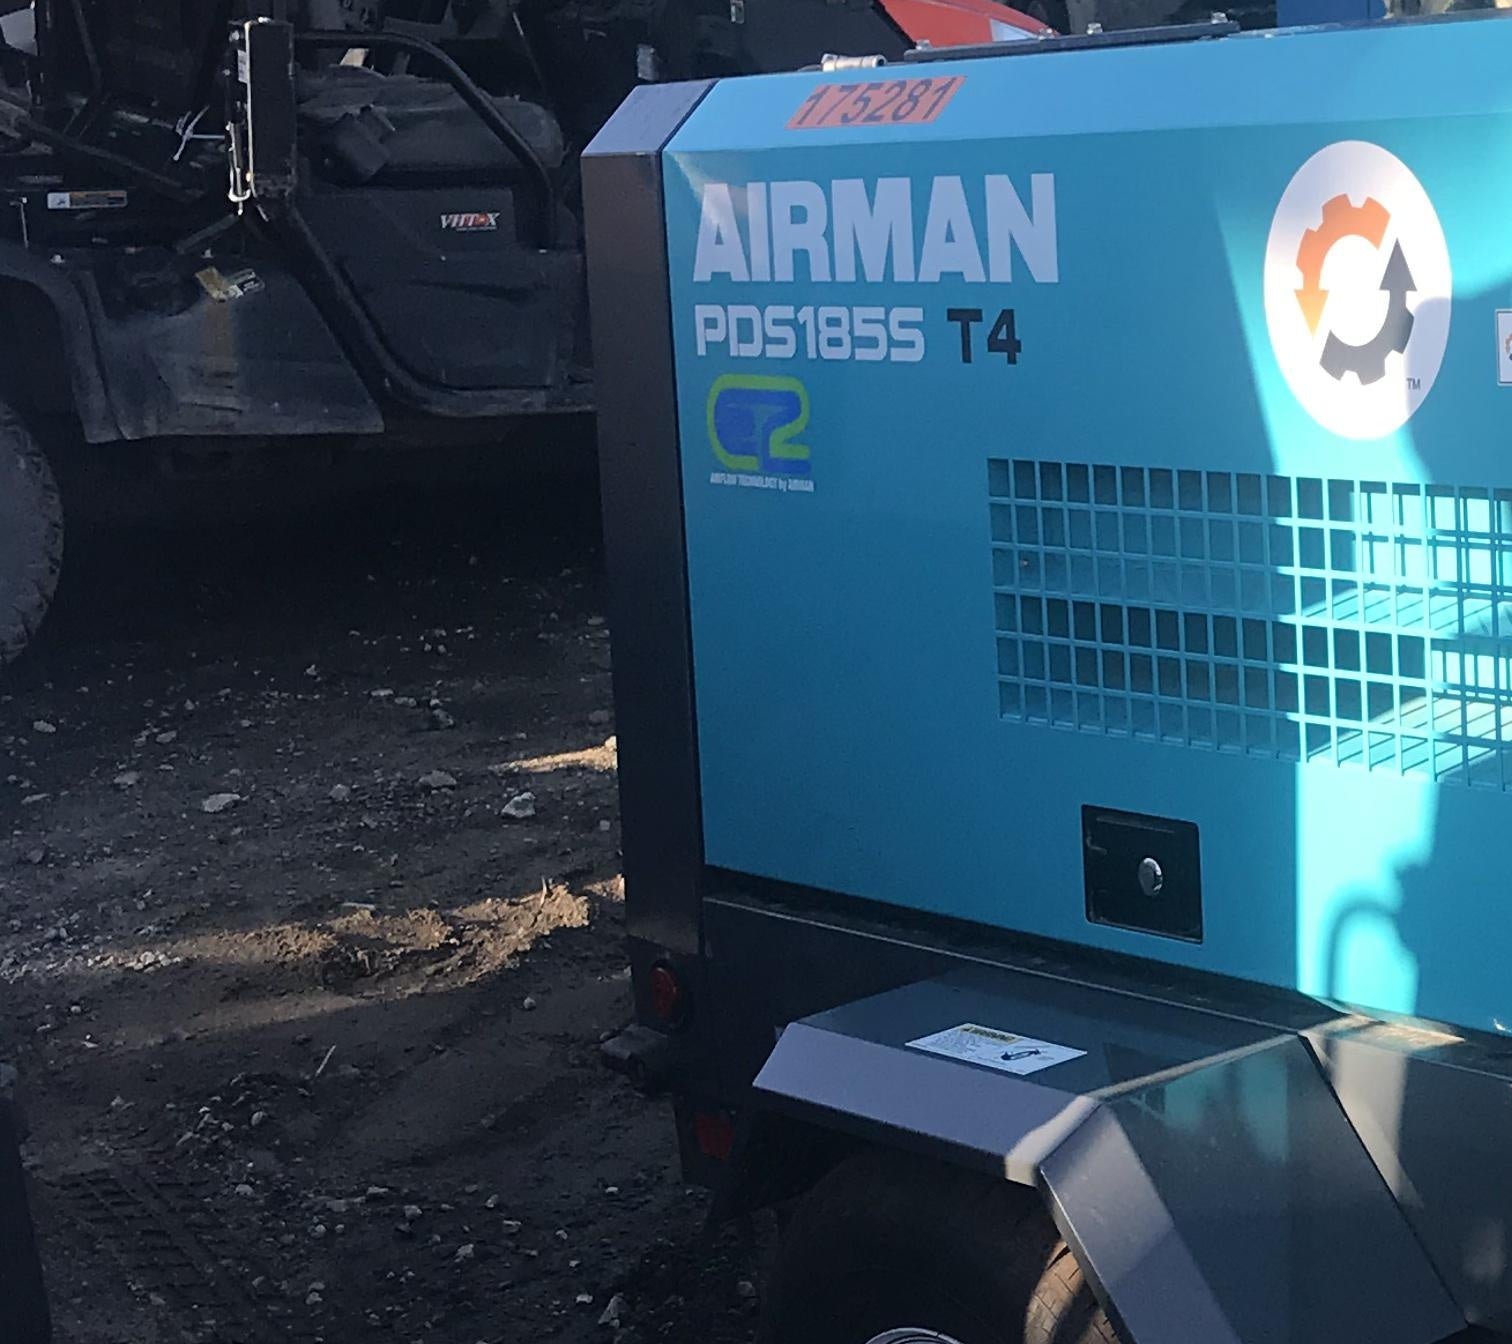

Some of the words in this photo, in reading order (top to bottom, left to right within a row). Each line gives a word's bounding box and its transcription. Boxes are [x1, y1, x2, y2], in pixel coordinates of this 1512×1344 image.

[796, 77, 958, 125] 175281
[693, 173, 1059, 283] AIRMAN
[694, 304, 925, 363] PDS185S
[946, 308, 1022, 365] T4
